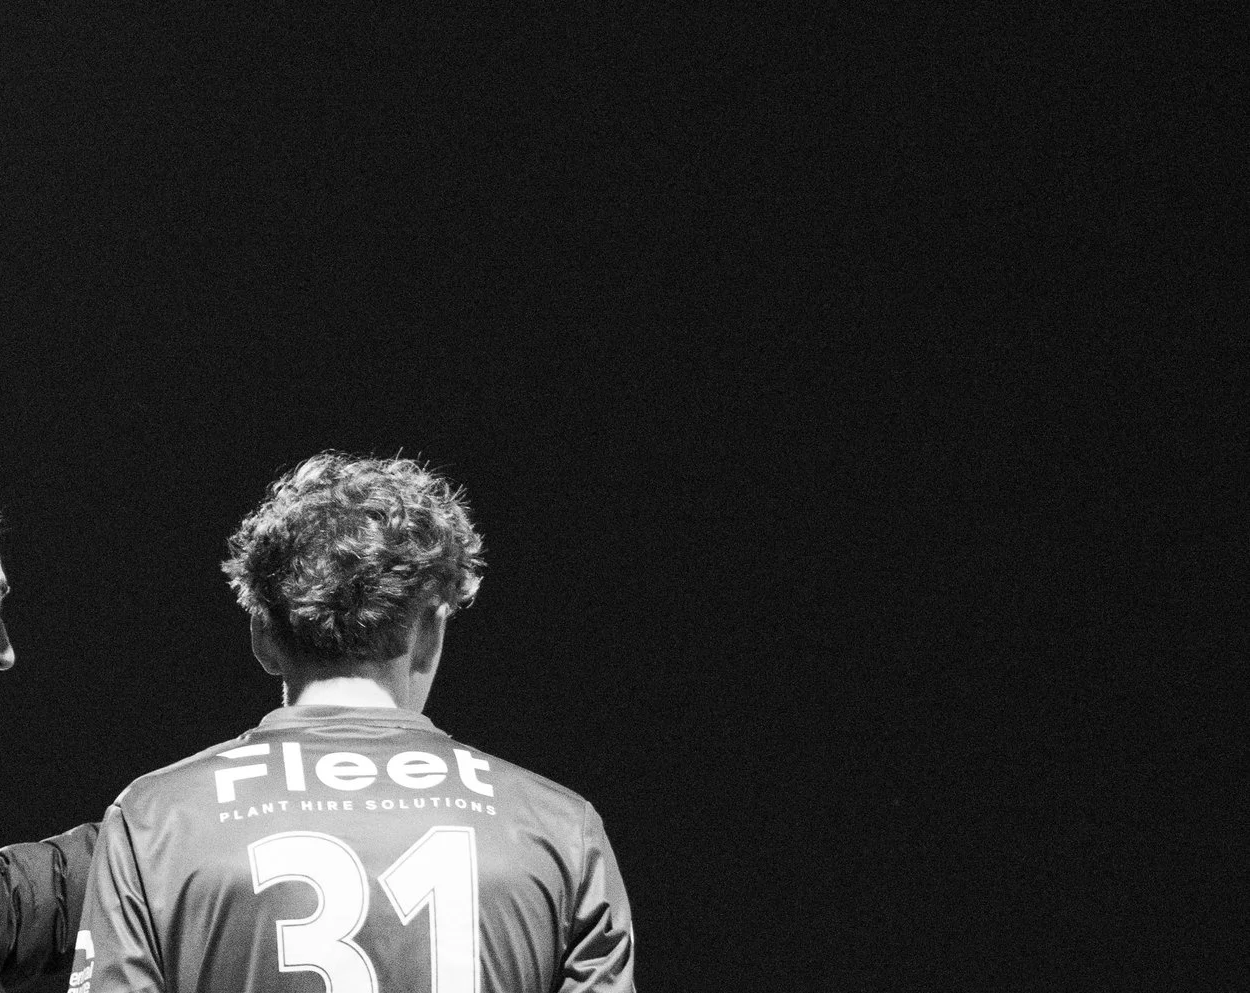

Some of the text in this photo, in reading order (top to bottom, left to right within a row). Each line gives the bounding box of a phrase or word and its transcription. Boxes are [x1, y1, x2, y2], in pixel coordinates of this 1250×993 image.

[213, 741, 495, 804] Fleet
[219, 797, 497, 824] PLANT HIRE SOLUTIONS
